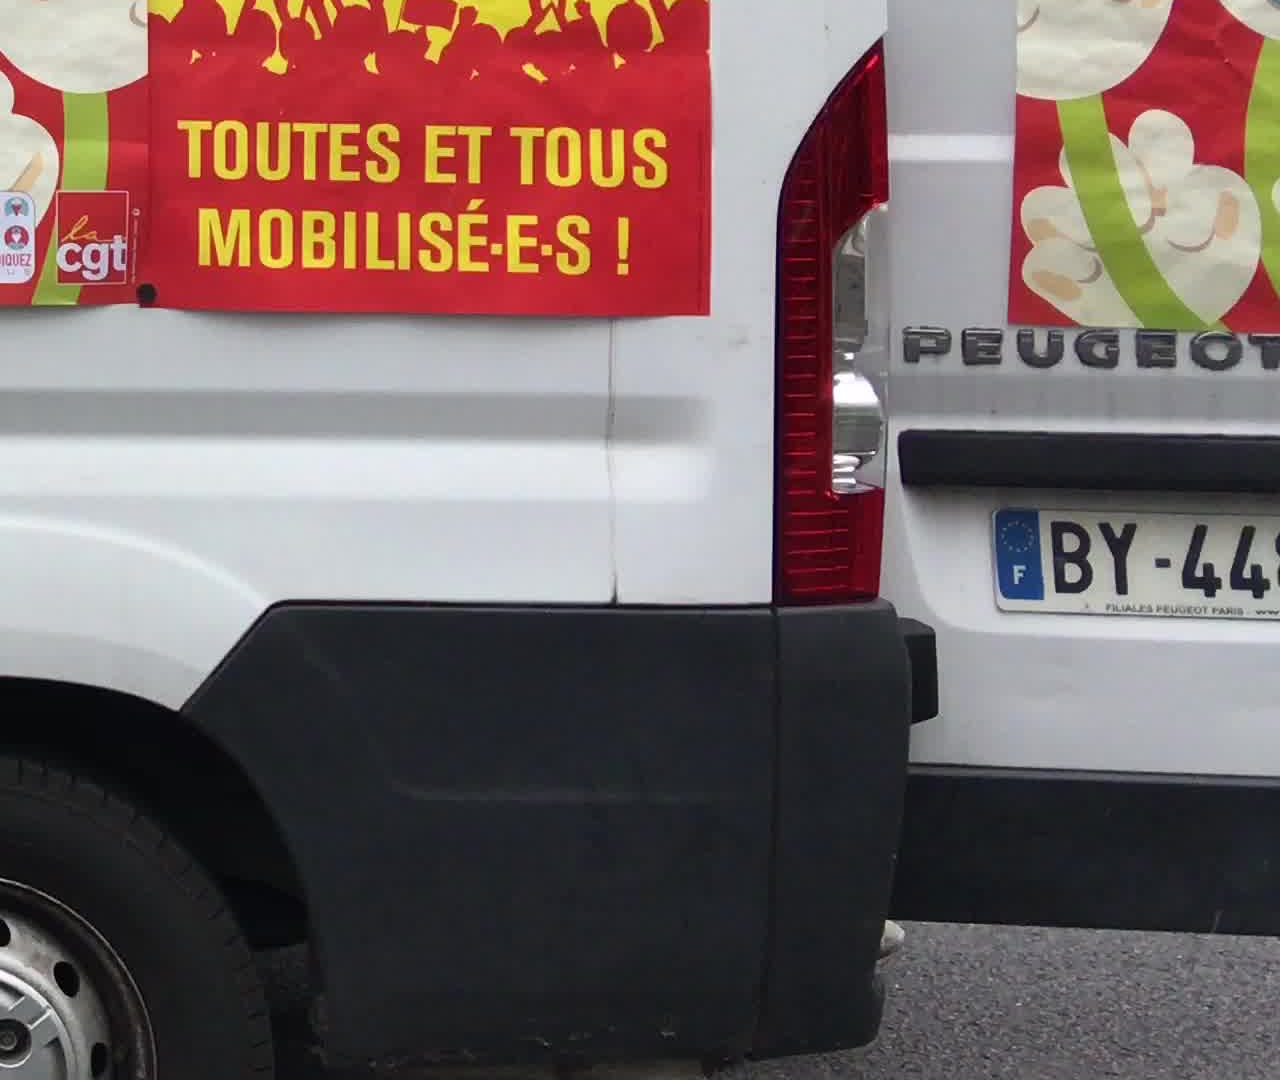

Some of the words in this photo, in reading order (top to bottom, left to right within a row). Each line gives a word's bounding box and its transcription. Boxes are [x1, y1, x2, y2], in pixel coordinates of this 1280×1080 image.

[177, 120, 401, 183] TOUTES
[424, 124, 492, 184] ET
[509, 126, 668, 188] TOUS
[56, 235, 128, 281] cgt
[616, 217, 629, 275] !
[901, 326, 1280, 370] PEUGEOT
[1013, 565, 1027, 585] F
[1050, 520, 1280, 599] BY-44
[1156, 605, 1209, 615] PEUGEOT
